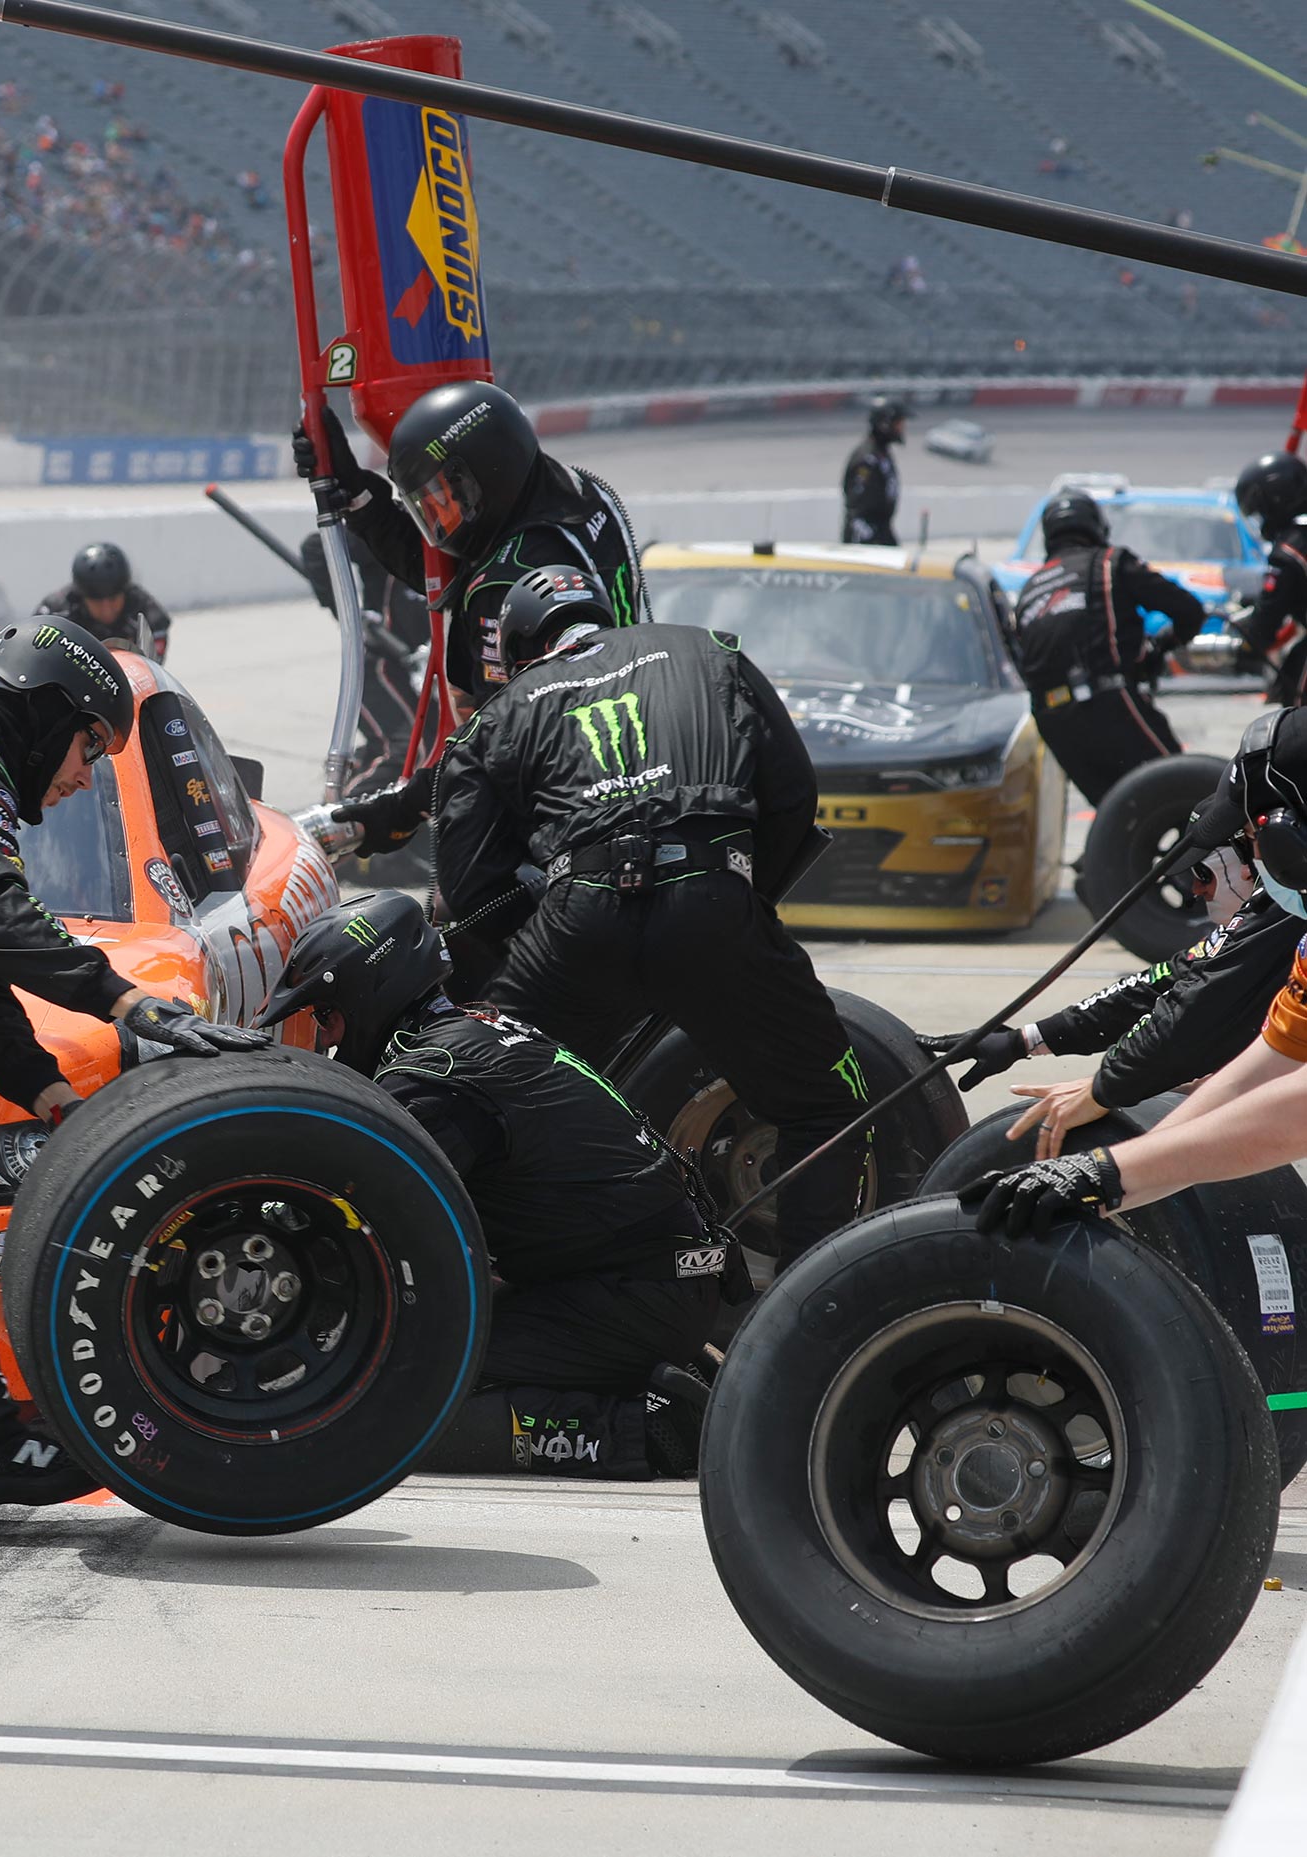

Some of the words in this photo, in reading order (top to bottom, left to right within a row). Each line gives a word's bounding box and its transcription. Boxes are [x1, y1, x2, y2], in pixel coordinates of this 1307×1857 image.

[424, 110, 481, 332] SUNOCO
[328, 344, 356, 383] 2
[441, 401, 492, 443] MONSTER
[740, 570, 850, 592] xfinity
[59, 636, 120, 696] MONSTER
[64, 652, 108, 690] ENERGY
[526, 649, 670, 703] MonsterEnergy.com
[364, 936, 396, 966] MONSTER
[69, 1174, 165, 1457] GOODYEAR
[12, 1439, 61, 1469] N
